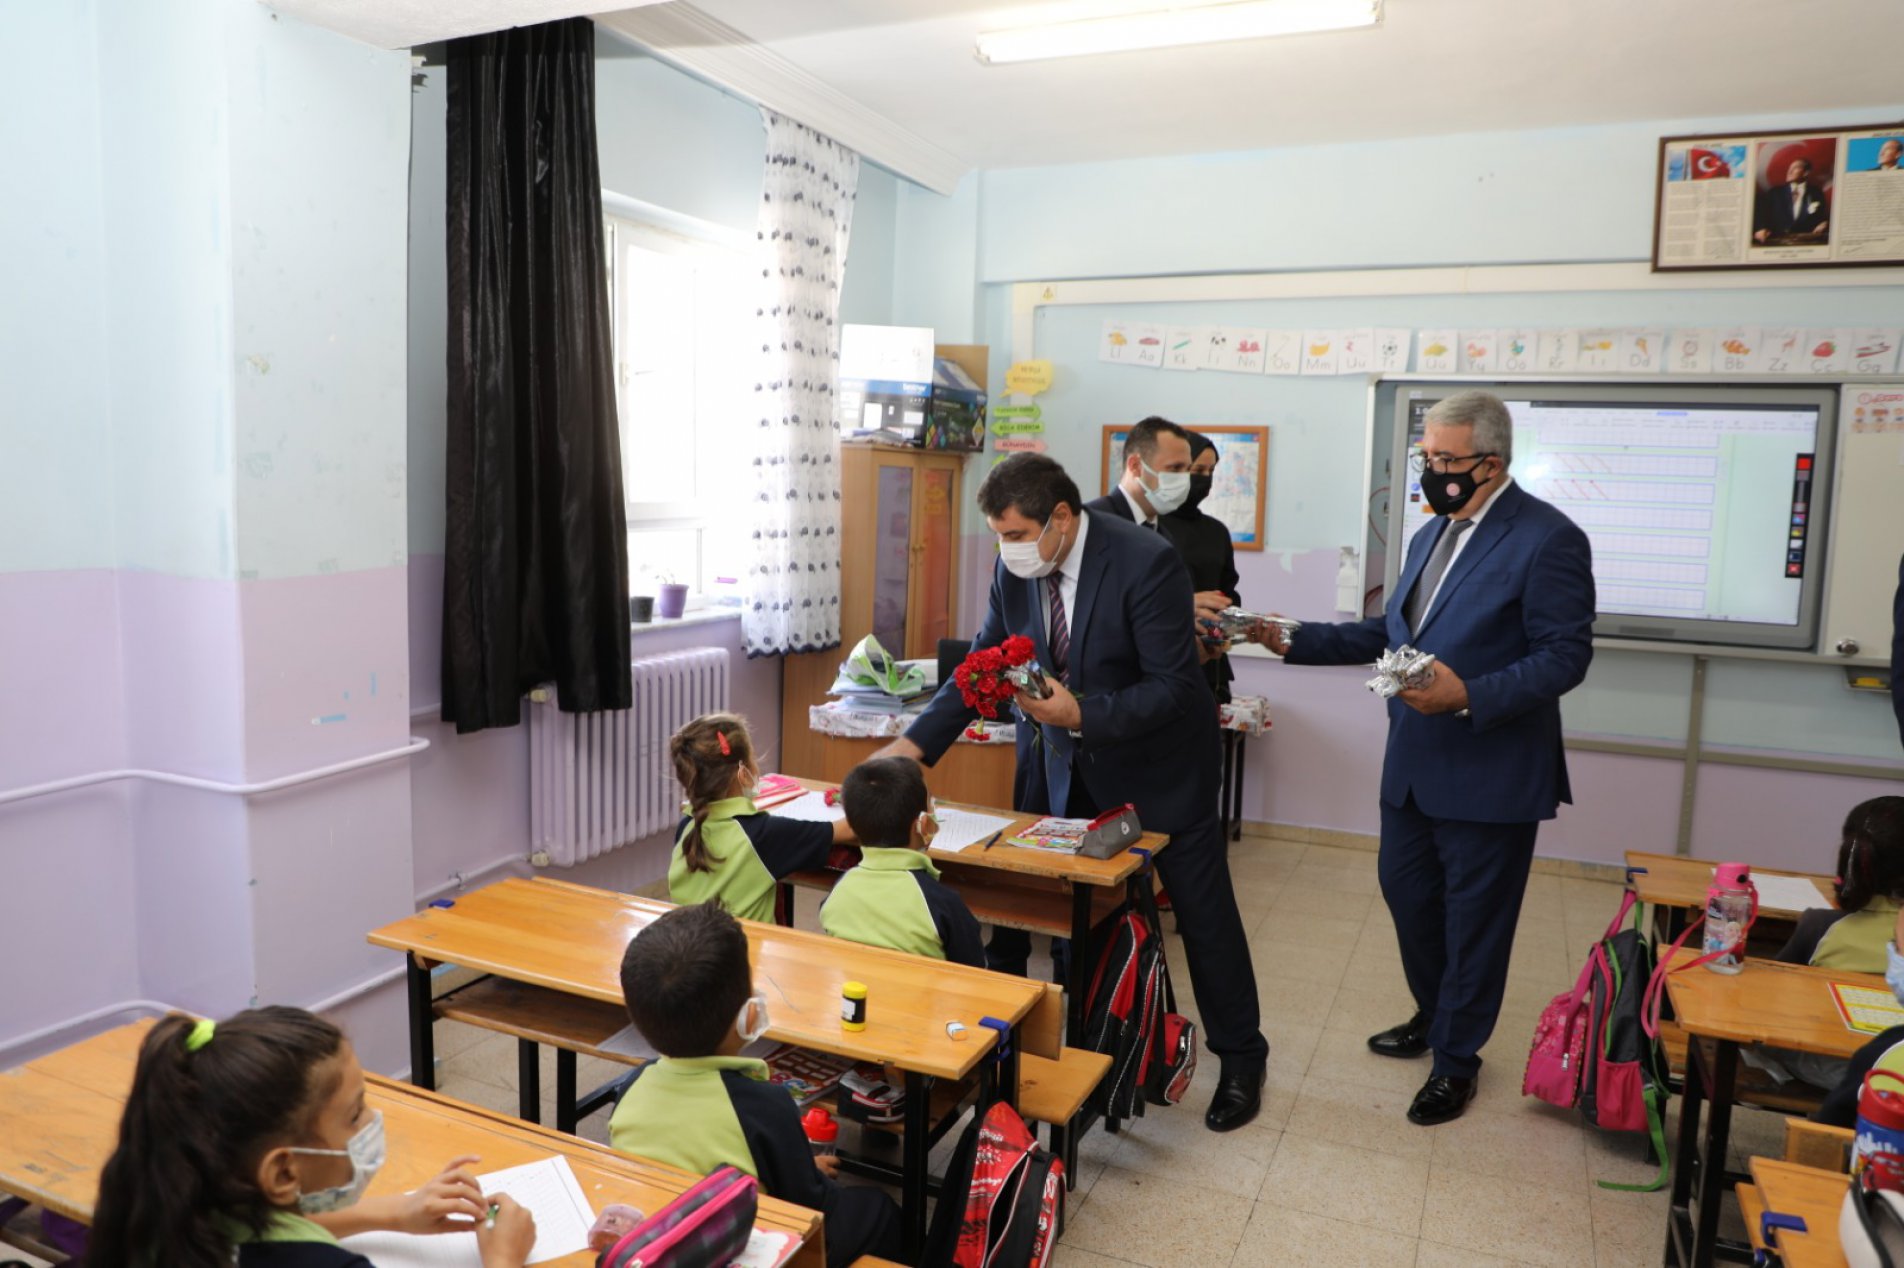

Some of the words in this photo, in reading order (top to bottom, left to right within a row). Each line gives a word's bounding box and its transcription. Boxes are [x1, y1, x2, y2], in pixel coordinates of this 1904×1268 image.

[1305, 357, 1331, 370] Mm
[1629, 353, 1651, 368] Dd
[1724, 357, 1745, 371] Bb
[1767, 357, 1789, 372] Zz
